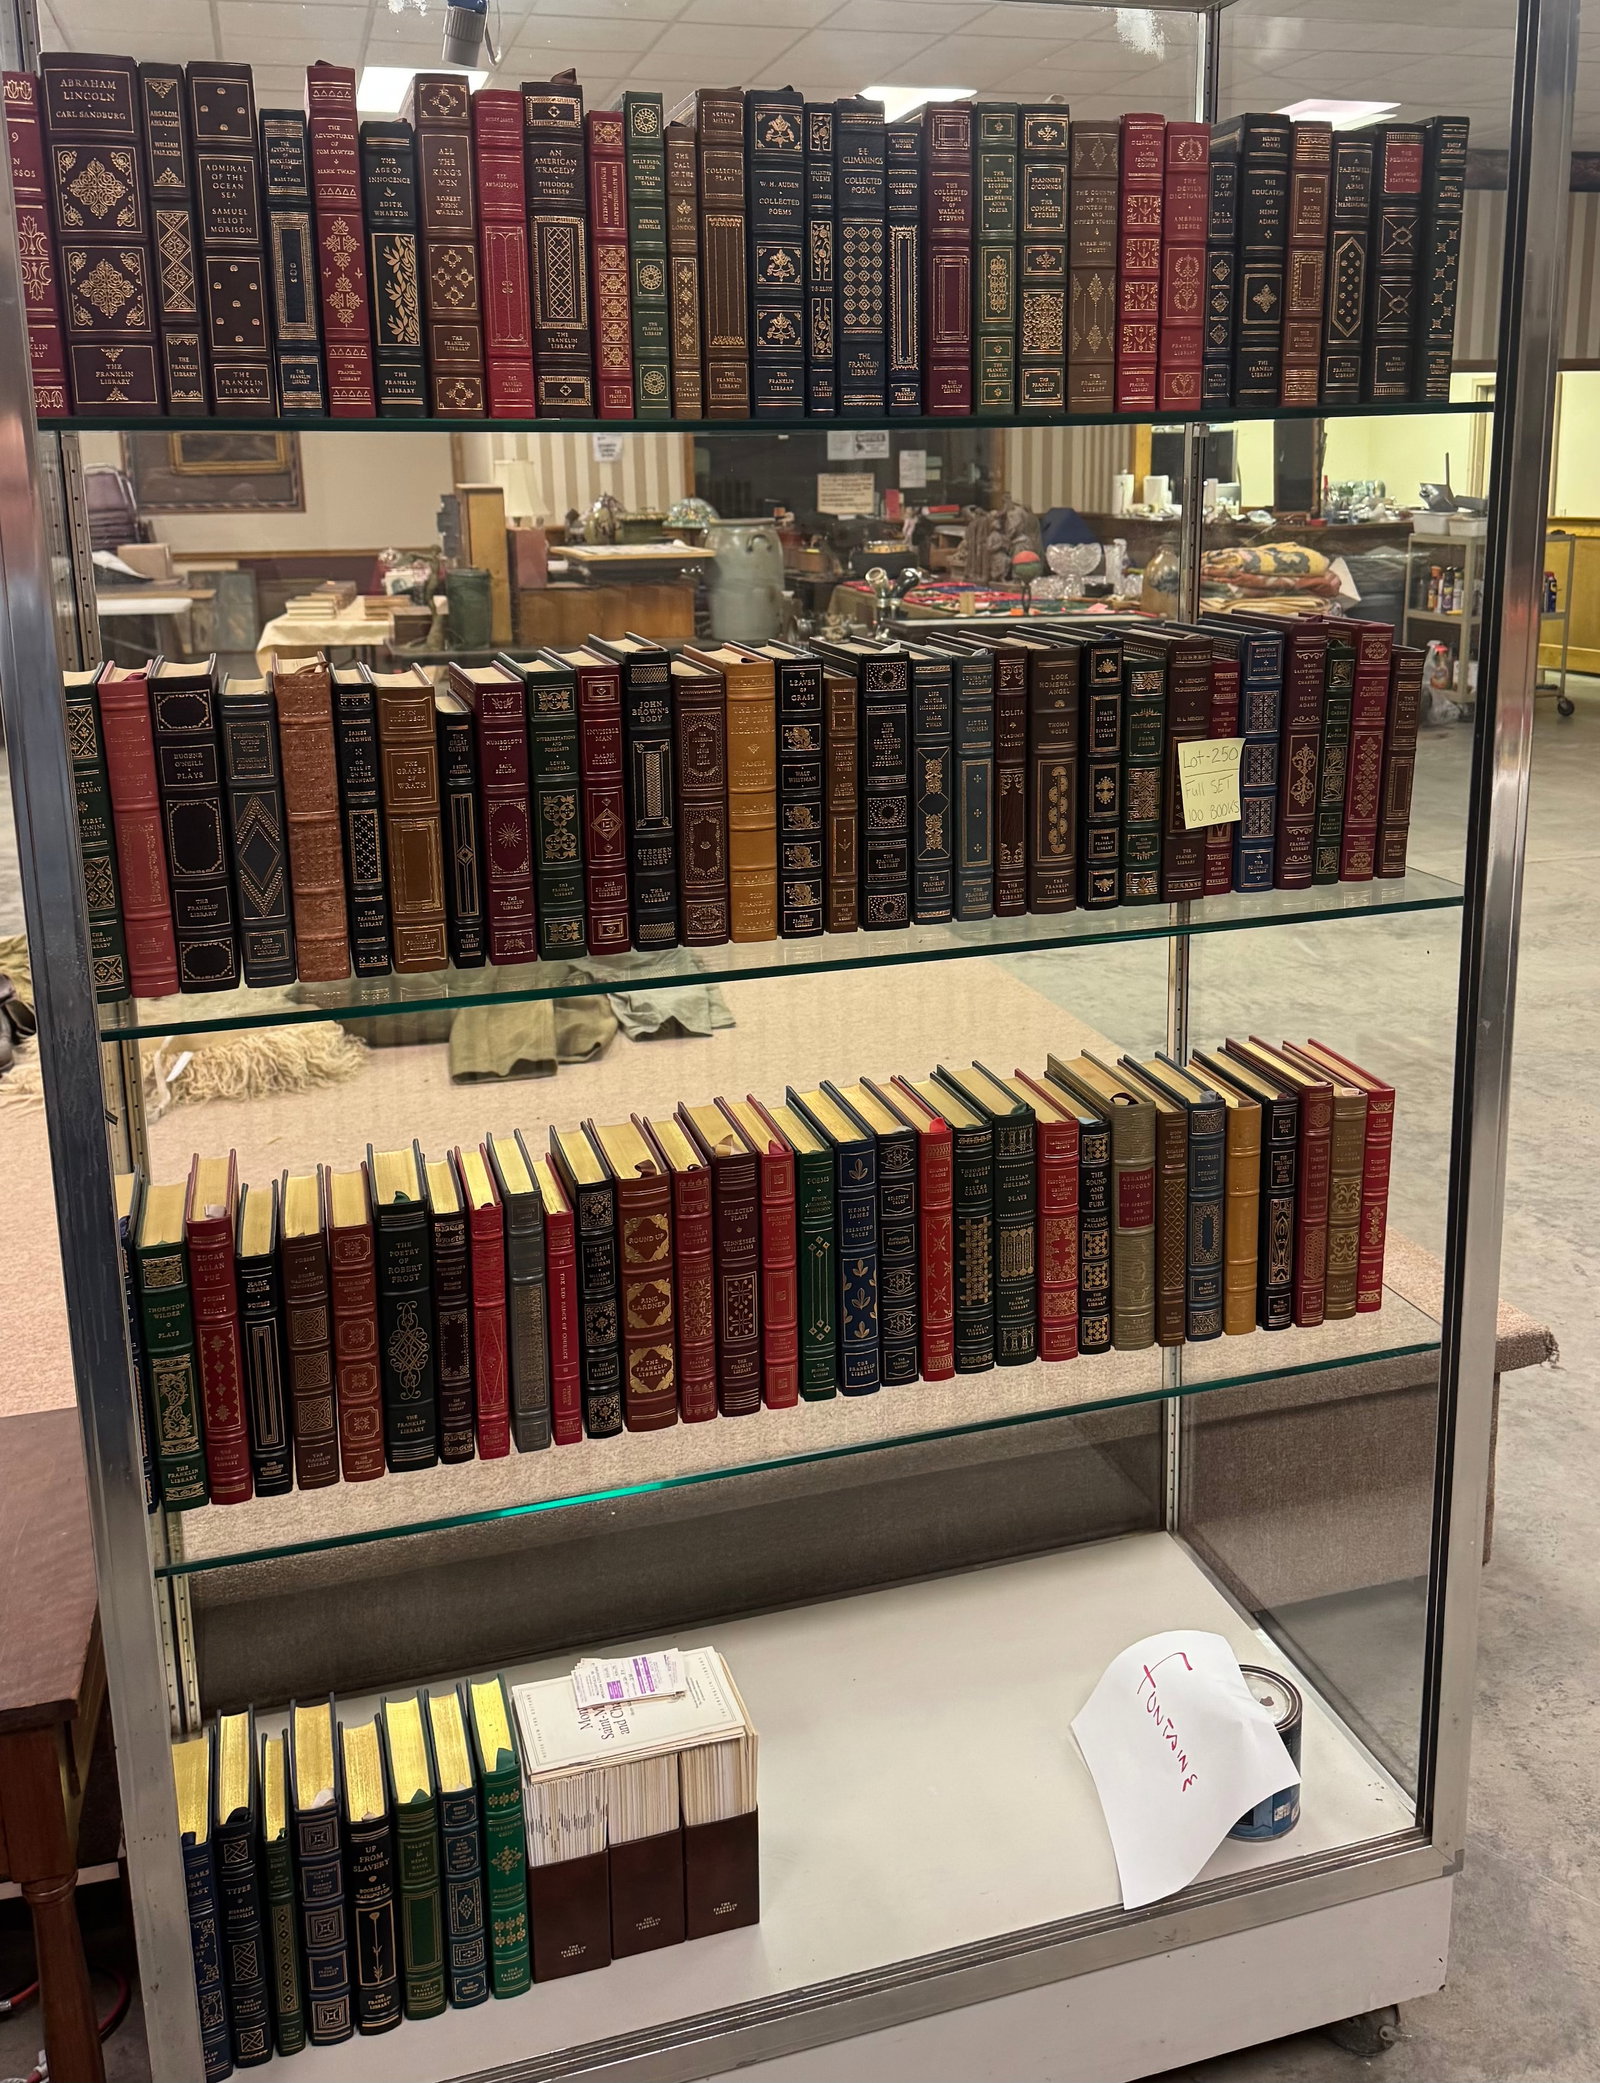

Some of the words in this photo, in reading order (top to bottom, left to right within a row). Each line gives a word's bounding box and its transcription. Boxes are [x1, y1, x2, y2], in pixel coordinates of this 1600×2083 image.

[60, 79, 117, 90] ABRAHAM
[63, 91, 116, 103] LINCOLN
[55, 110, 77, 120] CARL
[79, 110, 126, 120] SANDBURG
[438, 148, 455, 156] ALL
[534, 158, 577, 166] AMERICAN
[842, 156, 883, 165] CUMMINGS
[205, 164, 248, 172] ADMIRAL
[535, 167, 575, 175] TRAGEDY
[211, 173, 223, 181] OF
[368, 176, 411, 184] INNOCENCE
[844, 177, 883, 185] COLLECTED
[213, 182, 244, 190] OCEAN
[438, 179, 458, 187] MEN
[851, 186, 876, 194] POEMS
[221, 191, 237, 199] SEA
[759, 198, 800, 206] COLLECTED
[212, 208, 249, 216] SAMUEL
[768, 208, 792, 216] POEMS
[217, 217, 244, 225] ELIOT
[210, 225, 253, 235] MORISON
[848, 361, 880, 369] FRANKLIN
[850, 368, 877, 377] LIBRARY
[99, 377, 131, 385] LIBRARY
[220, 379, 264, 387] FRANKLIN
[384, 379, 417, 387] FRANKLIN
[224, 387, 261, 395] LIBRARY
[387, 387, 415, 395] LIBRARY
[639, 700, 663, 709] JOHN
[631, 707, 670, 716] BROWN'S
[640, 715, 663, 723] BODY
[1090, 1185, 1104, 1193] AND
[628, 1235, 654, 1245] ROUND
[655, 1233, 665, 1241] UP
[388, 1263, 423, 1274] ROBERT
[391, 1273, 420, 1283] FROST
[365, 1845, 377, 1853] UP
[359, 1852, 384, 1863] FROM
[353, 1858, 390, 1873] SLAVERY
